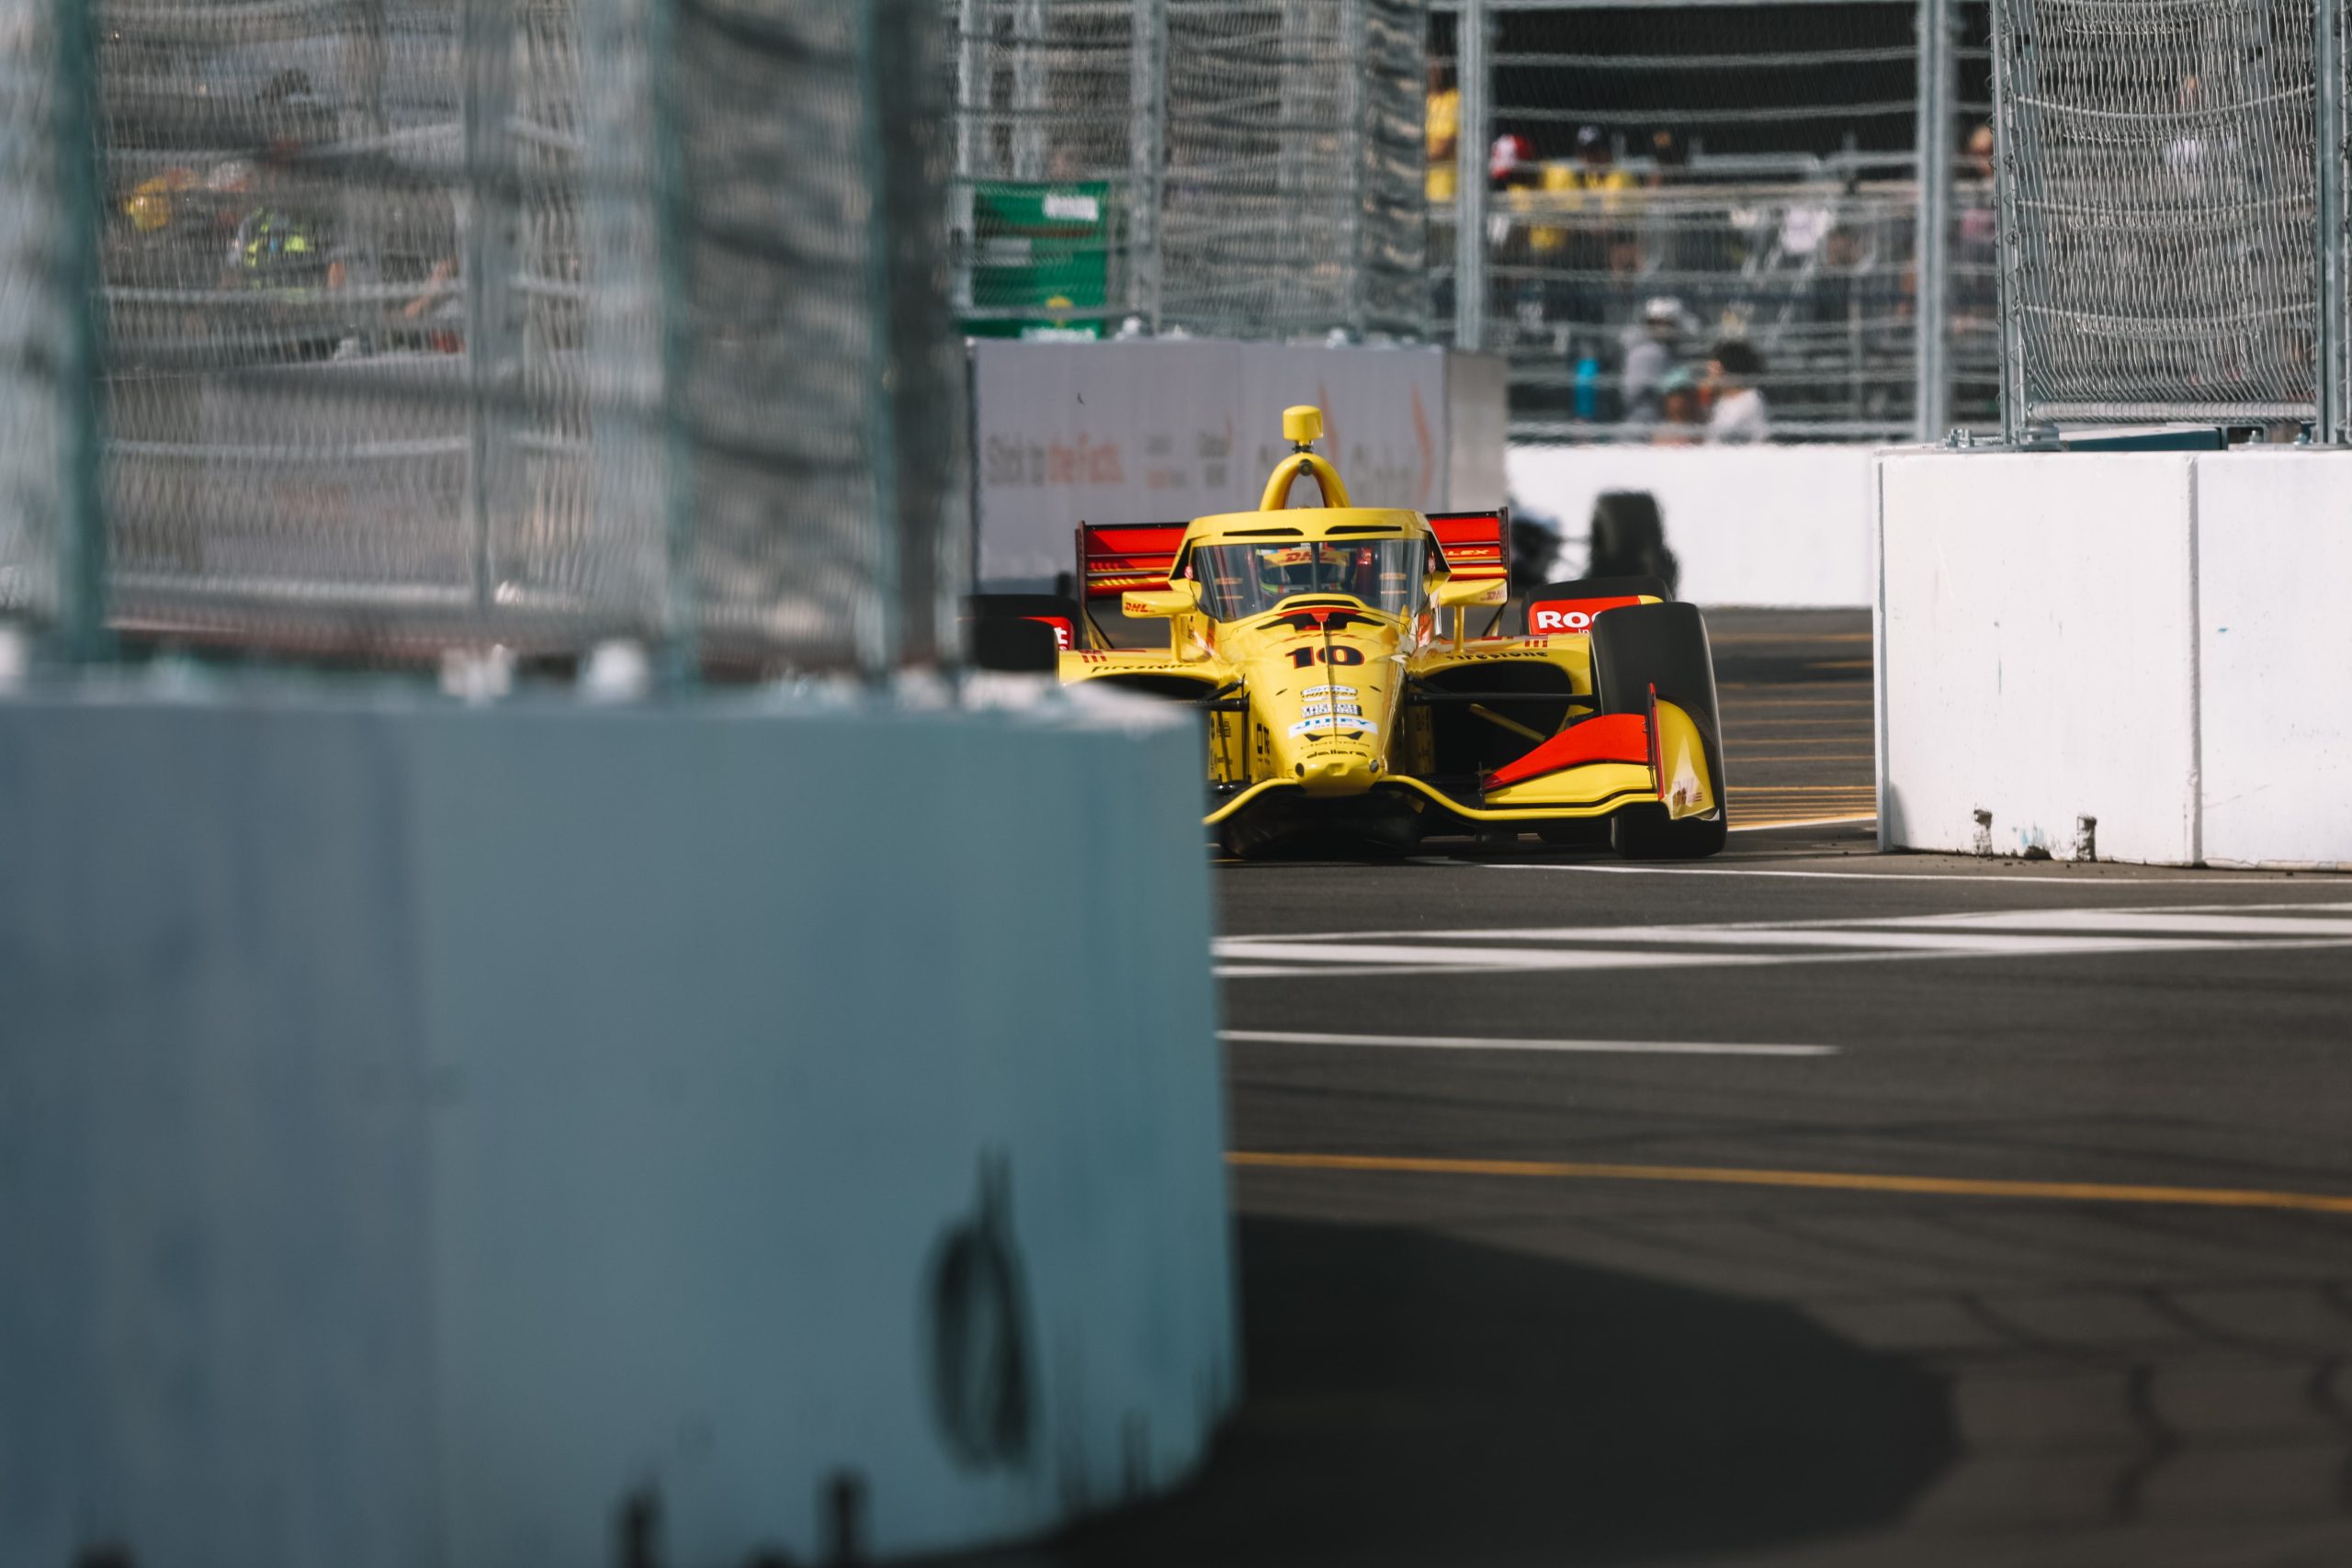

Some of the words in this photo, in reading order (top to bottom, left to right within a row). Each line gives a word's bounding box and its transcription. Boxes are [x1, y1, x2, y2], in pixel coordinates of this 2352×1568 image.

[1125, 602, 1148, 613] DHL
[1537, 611, 1600, 628] RO
[1285, 646, 1365, 670] 10
[1306, 749, 1368, 759] dallara
